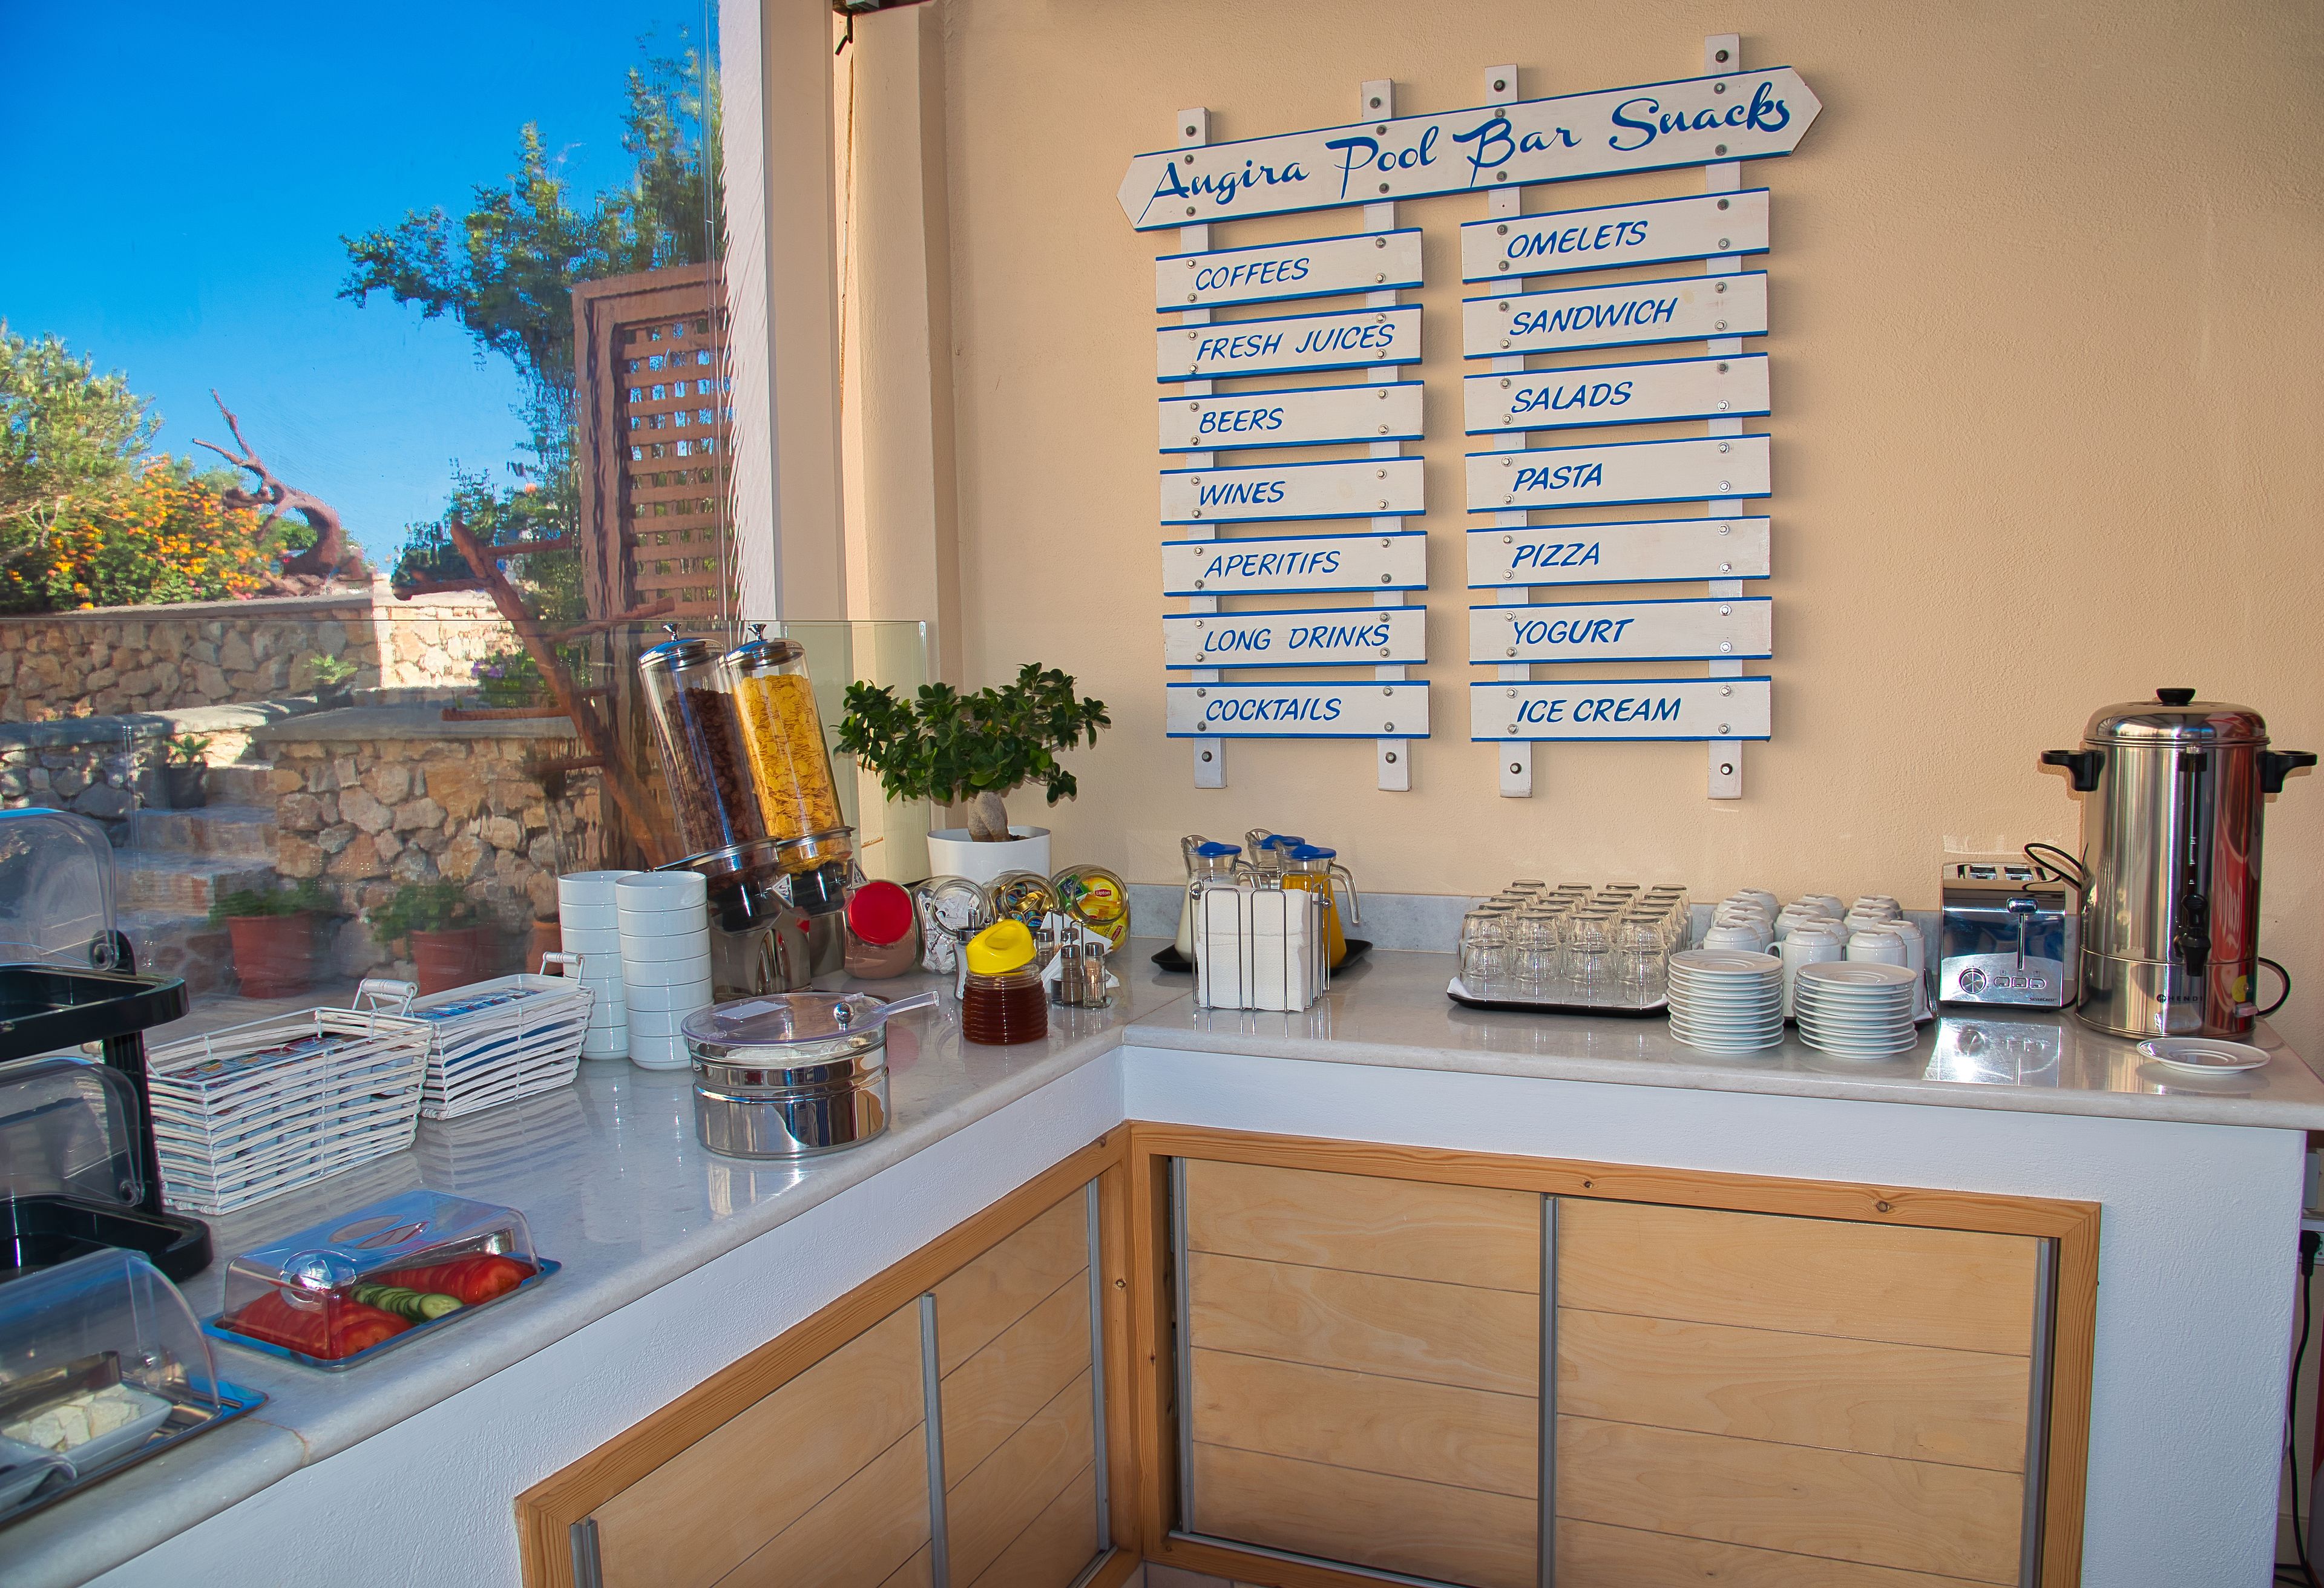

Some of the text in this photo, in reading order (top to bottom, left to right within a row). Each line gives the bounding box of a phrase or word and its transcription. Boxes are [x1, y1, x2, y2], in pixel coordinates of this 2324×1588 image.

[1137, 82, 1791, 225] Angira Pool Bar Snacks
[1507, 220, 1648, 259] OMELETS
[1195, 258, 1309, 291] COFFEES
[1509, 297, 1679, 336] SANDWICH
[1196, 324, 1395, 361] FRESH JUICES
[1511, 381, 1633, 413] SALADS
[1200, 408, 1284, 434] BEERS
[1512, 463, 1603, 492] PASTA
[1200, 481, 1285, 506] WINES
[1204, 550, 1341, 579] APERITIFS
[1511, 542, 1600, 569] PIZZA
[1204, 624, 1390, 652] LONG DRINKS
[1514, 618, 1633, 645] YOGURT
[1206, 697, 1342, 721] COCKTAILS
[1517, 698, 1682, 723] ICE CREAM
